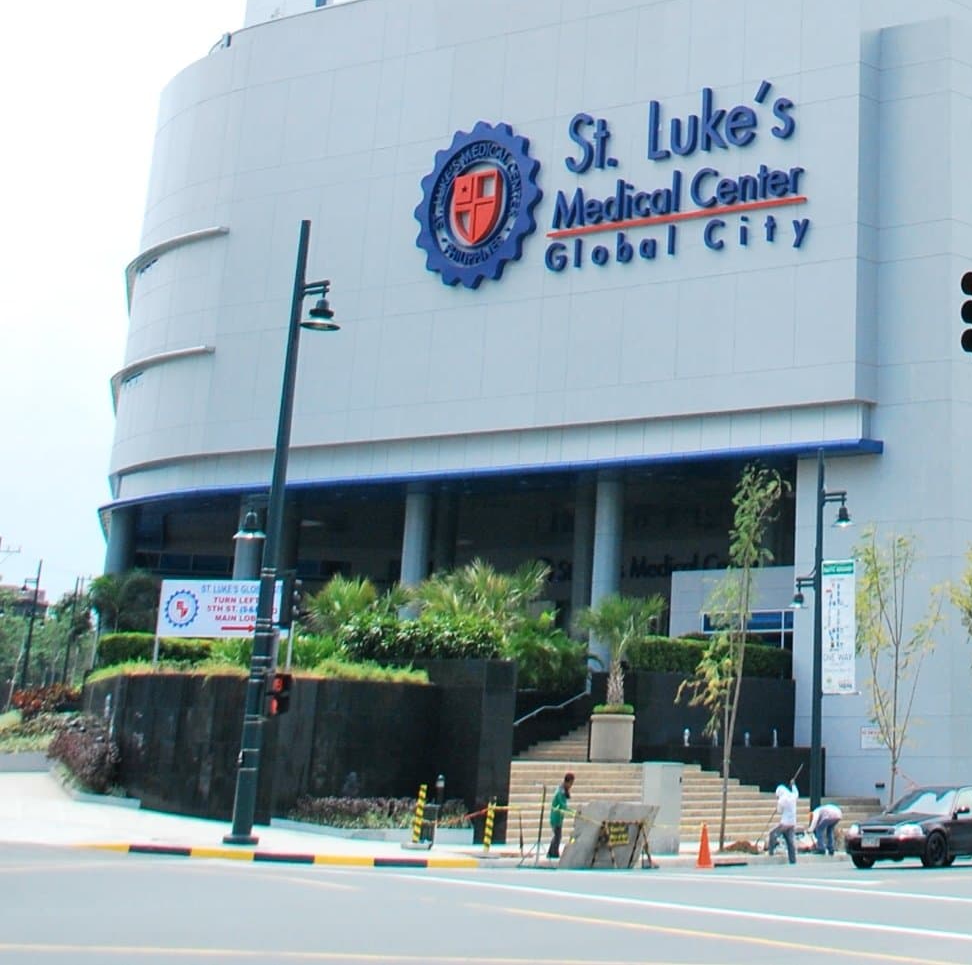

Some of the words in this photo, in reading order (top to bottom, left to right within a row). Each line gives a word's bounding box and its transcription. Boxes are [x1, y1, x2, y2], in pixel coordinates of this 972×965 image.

[565, 111, 619, 174] St.
[647, 79, 796, 162] Luke's
[551, 169, 682, 230] Medical
[690, 163, 805, 208] Center
[545, 224, 677, 272] Global
[703, 214, 810, 251] City
[214, 596, 237, 604] TURN
[239, 596, 259, 604] LEFT
[215, 614, 237, 622] MAIN
[239, 614, 257, 622] LOB
